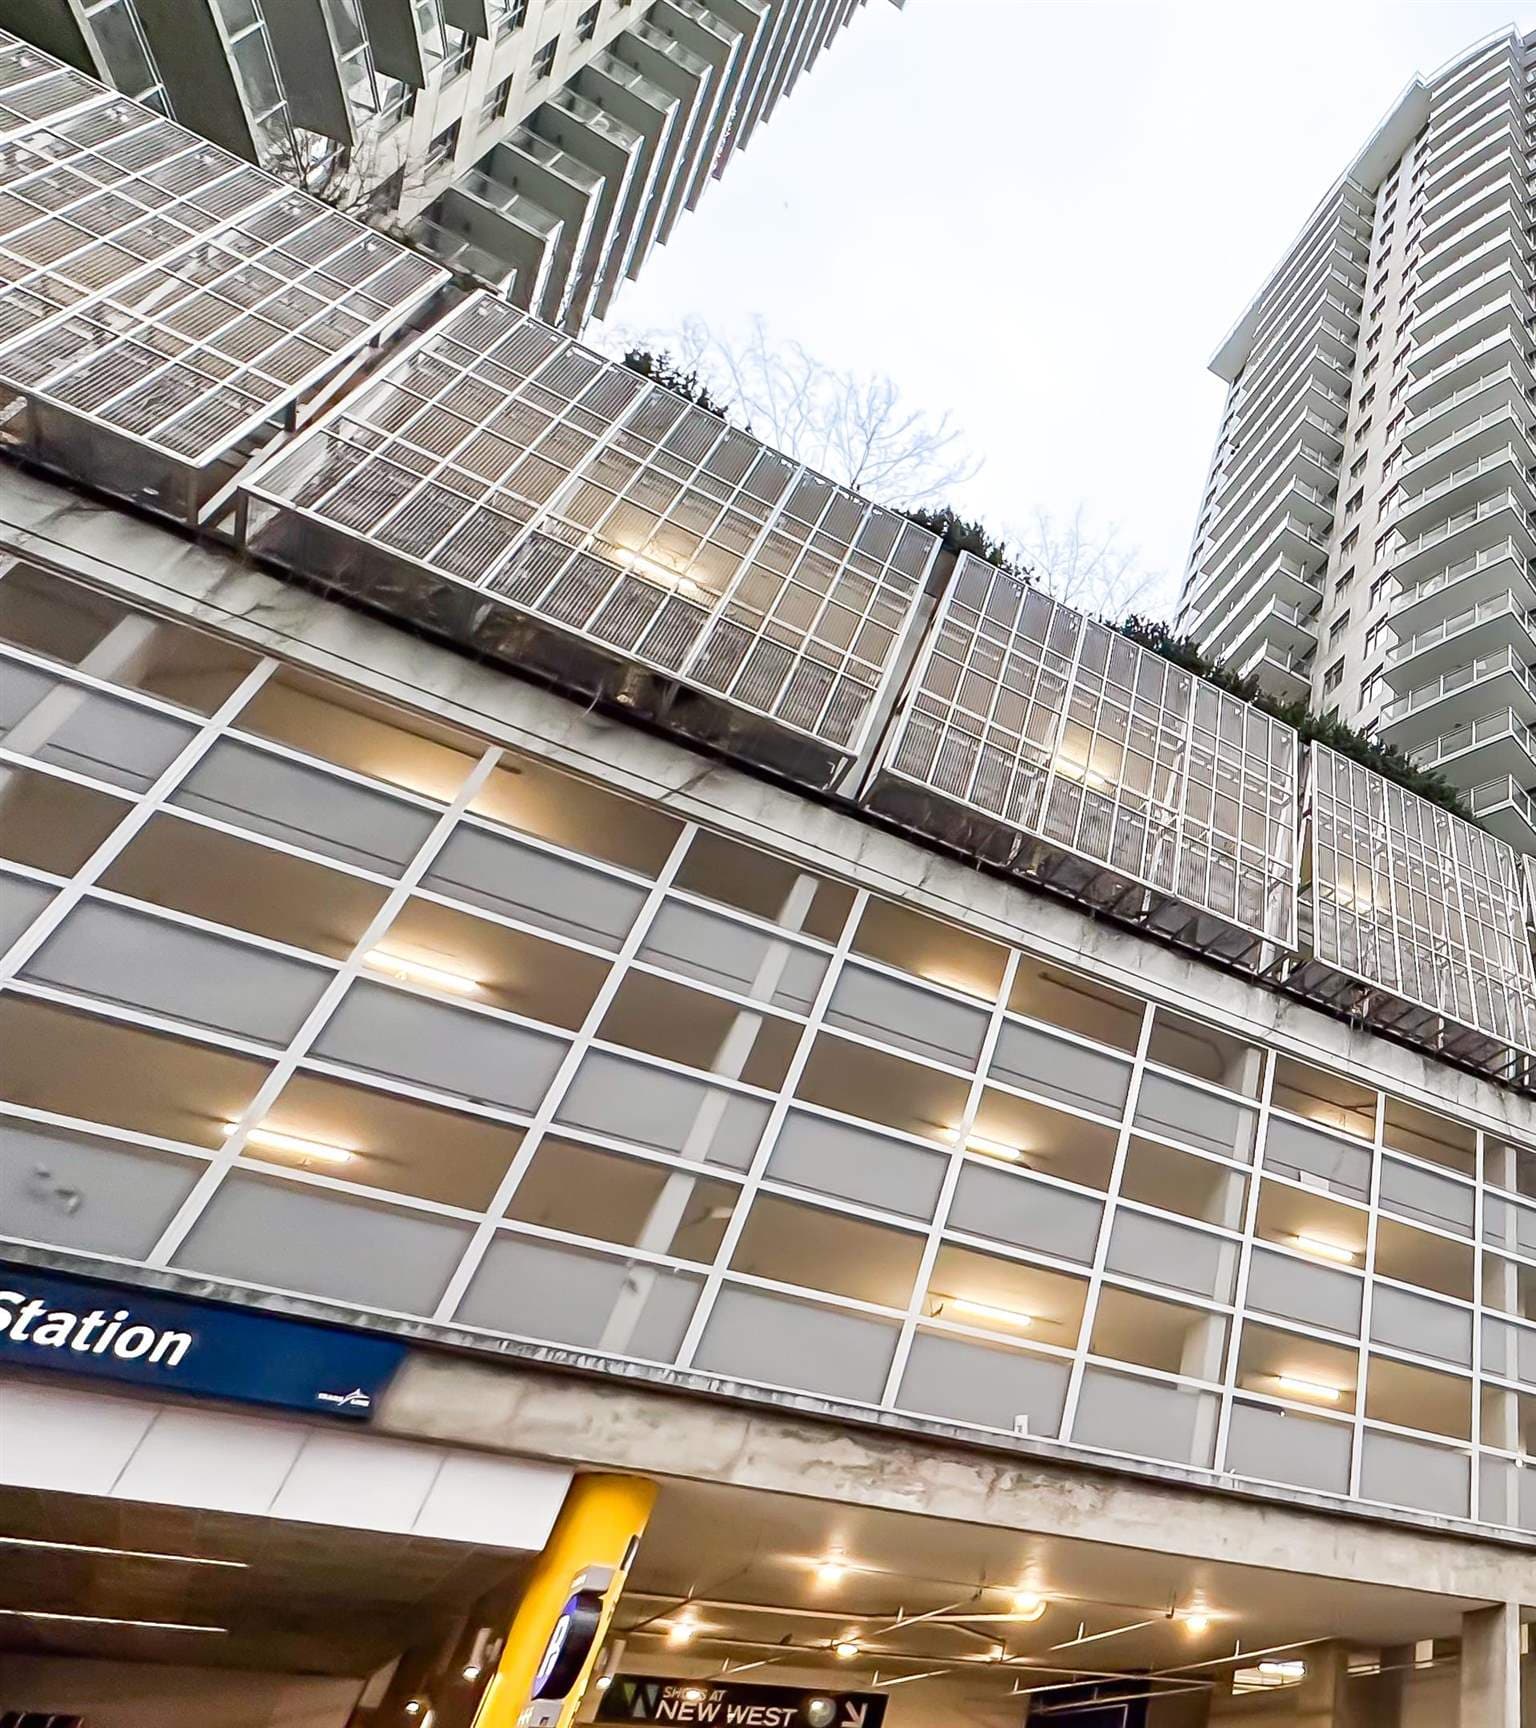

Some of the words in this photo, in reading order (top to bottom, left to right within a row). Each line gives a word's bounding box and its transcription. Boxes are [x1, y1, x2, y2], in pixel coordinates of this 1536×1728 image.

[709, 1690, 727, 1702] AT
[655, 1699, 721, 1722] NEW
[726, 1703, 798, 1727] WEST
